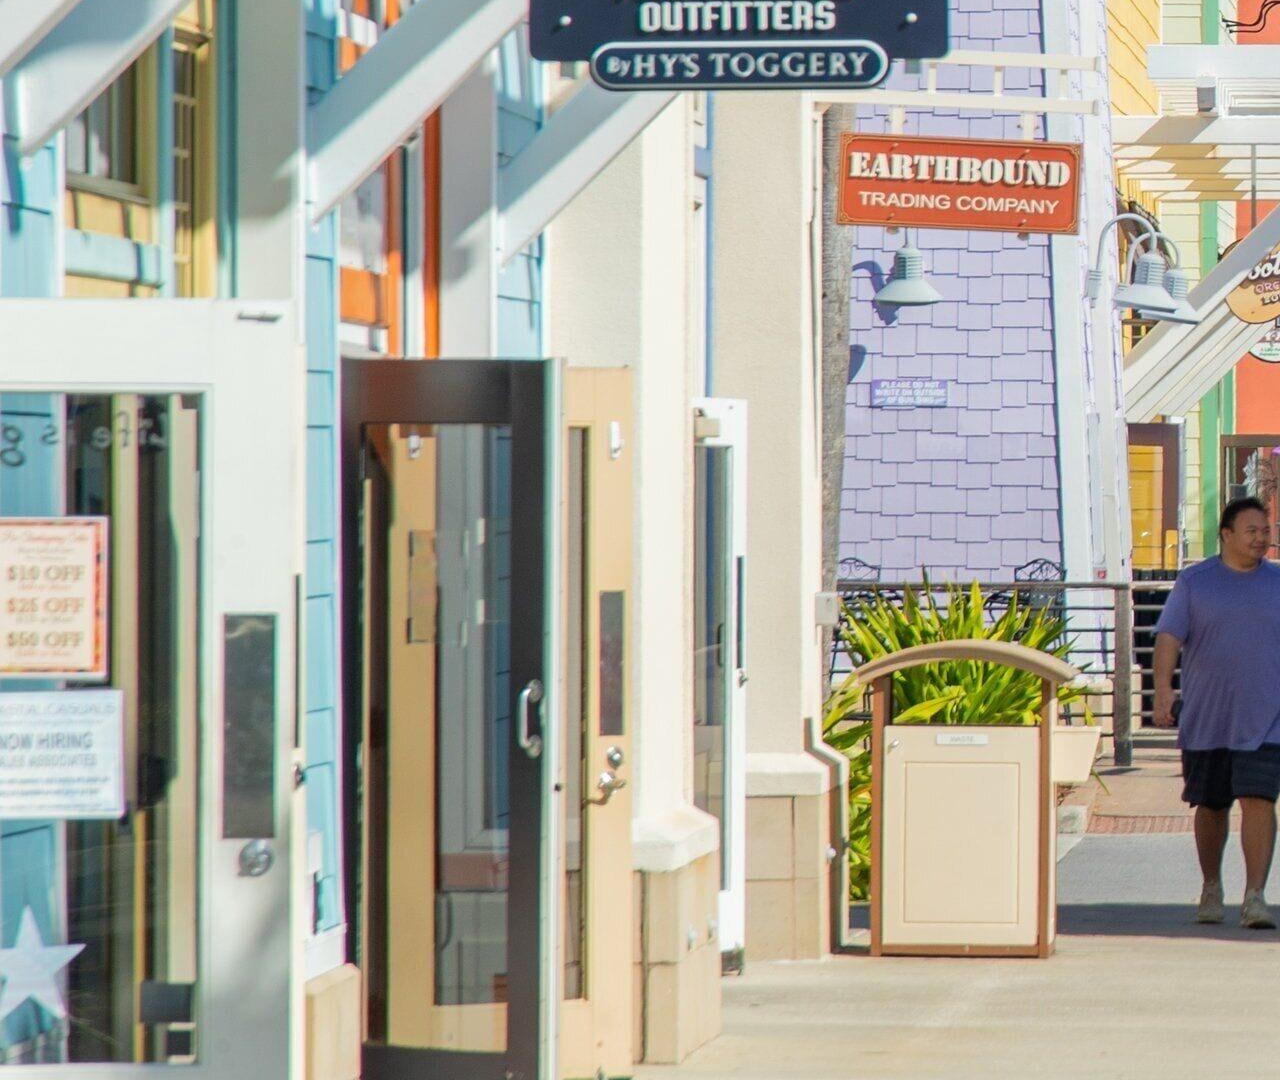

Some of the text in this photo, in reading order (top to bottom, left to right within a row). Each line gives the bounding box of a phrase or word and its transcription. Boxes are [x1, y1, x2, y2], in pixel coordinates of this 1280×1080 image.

[638, 0, 837, 34] OUTFITTERS
[606, 50, 871, 80] By HY'S TOGGERY
[848, 151, 1073, 189] EARTHBOUND
[858, 190, 1060, 216] TRADING COMPANY
[45, 565, 84, 581] OFF
[45, 597, 84, 613] OFF
[45, 631, 84, 647] OFF
[38, 731, 94, 749] HIRING
